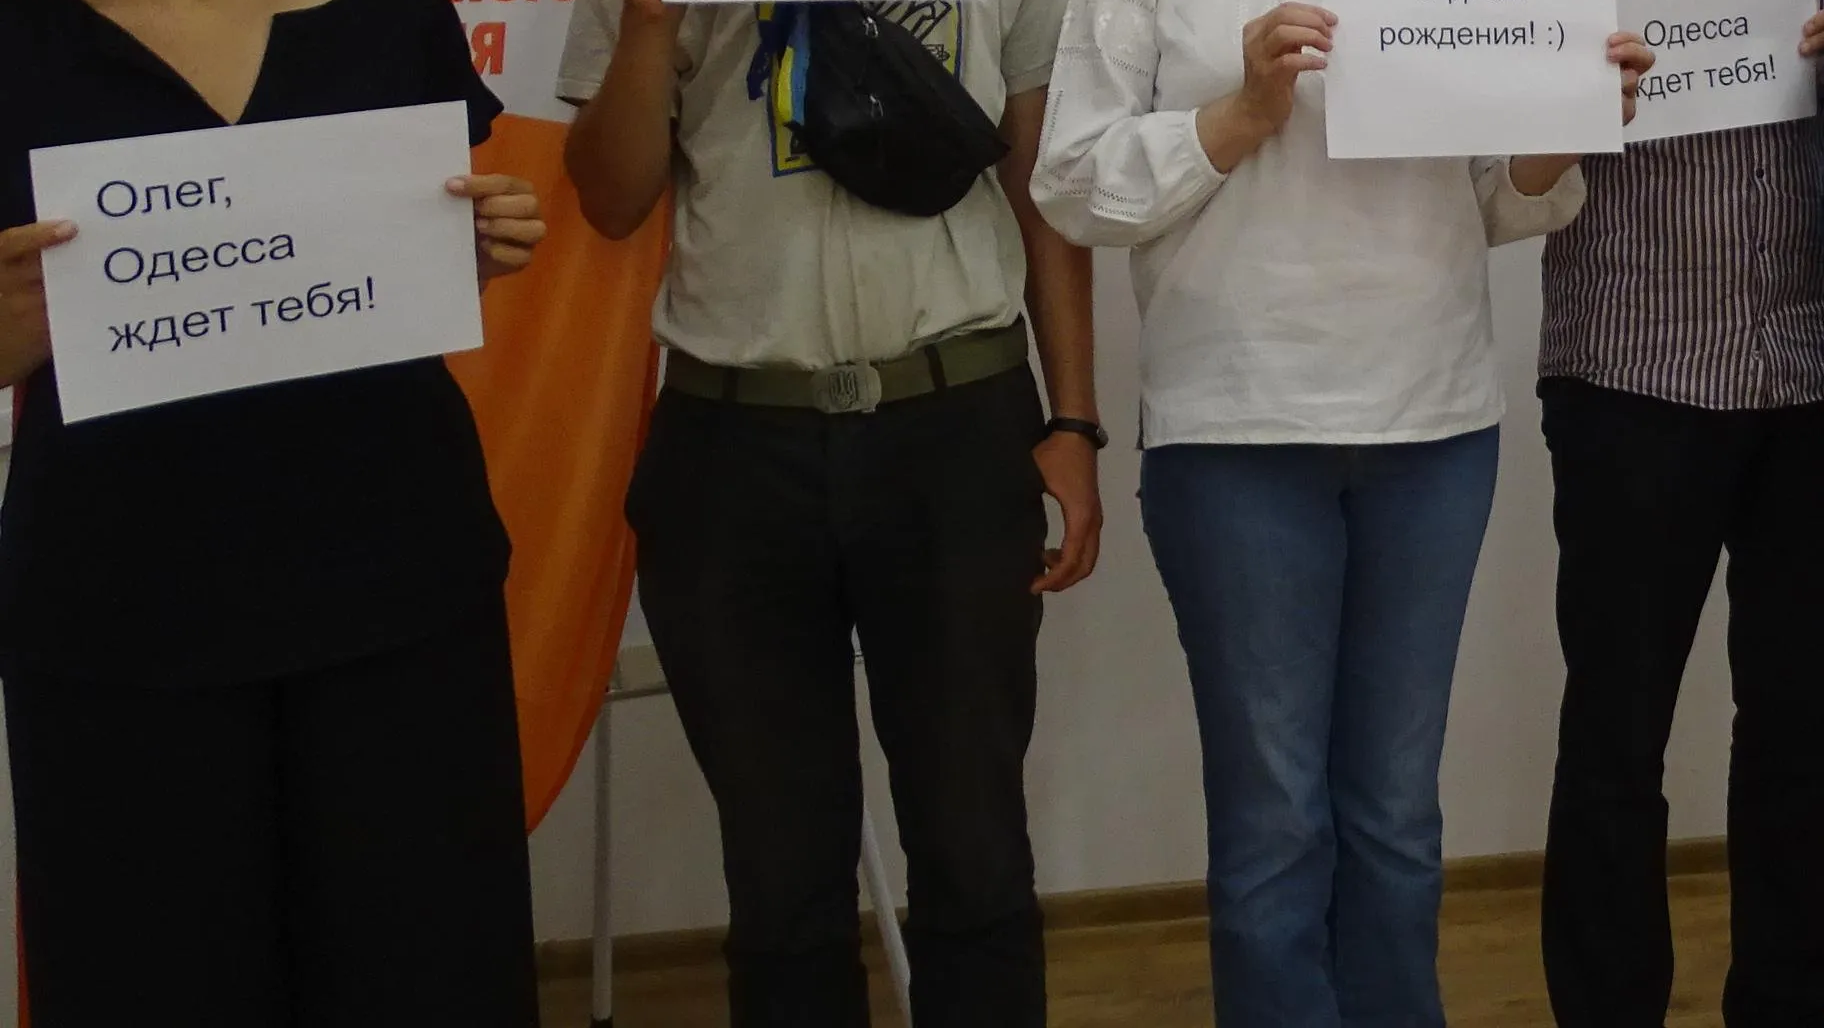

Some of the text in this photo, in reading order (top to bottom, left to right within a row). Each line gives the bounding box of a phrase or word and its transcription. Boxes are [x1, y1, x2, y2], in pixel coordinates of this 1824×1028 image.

[1380, 20, 1565, 52] рождения! :)
[1643, 16, 1749, 50] Одесса
[1703, 53, 1776, 88] тебя!
[96, 176, 232, 218] Олег,
[103, 234, 295, 286] Одесса
[108, 275, 375, 352] ждет тебя!
